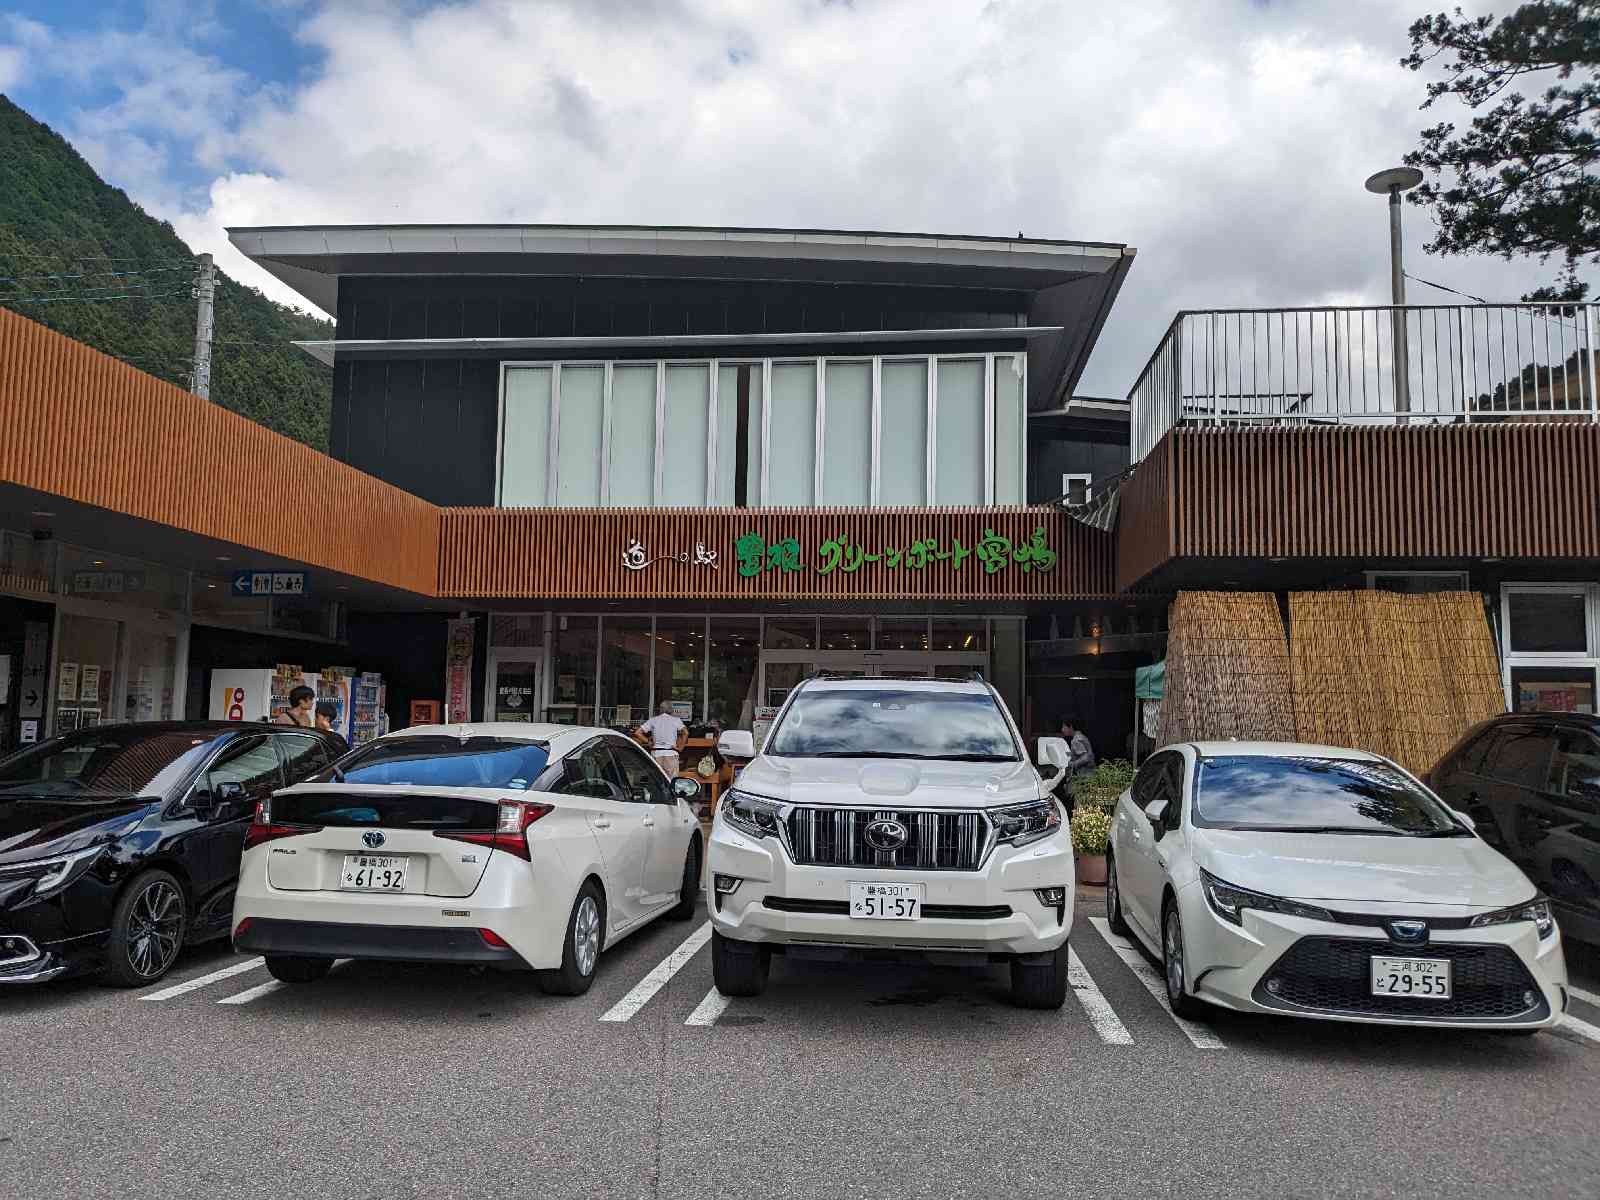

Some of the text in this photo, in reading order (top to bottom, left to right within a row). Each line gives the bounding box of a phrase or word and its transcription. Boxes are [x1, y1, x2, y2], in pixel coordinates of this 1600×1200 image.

[355, 869, 402, 888] 61-92
[865, 897, 916, 917] 51-57
[1388, 974, 1446, 995] 29-55
